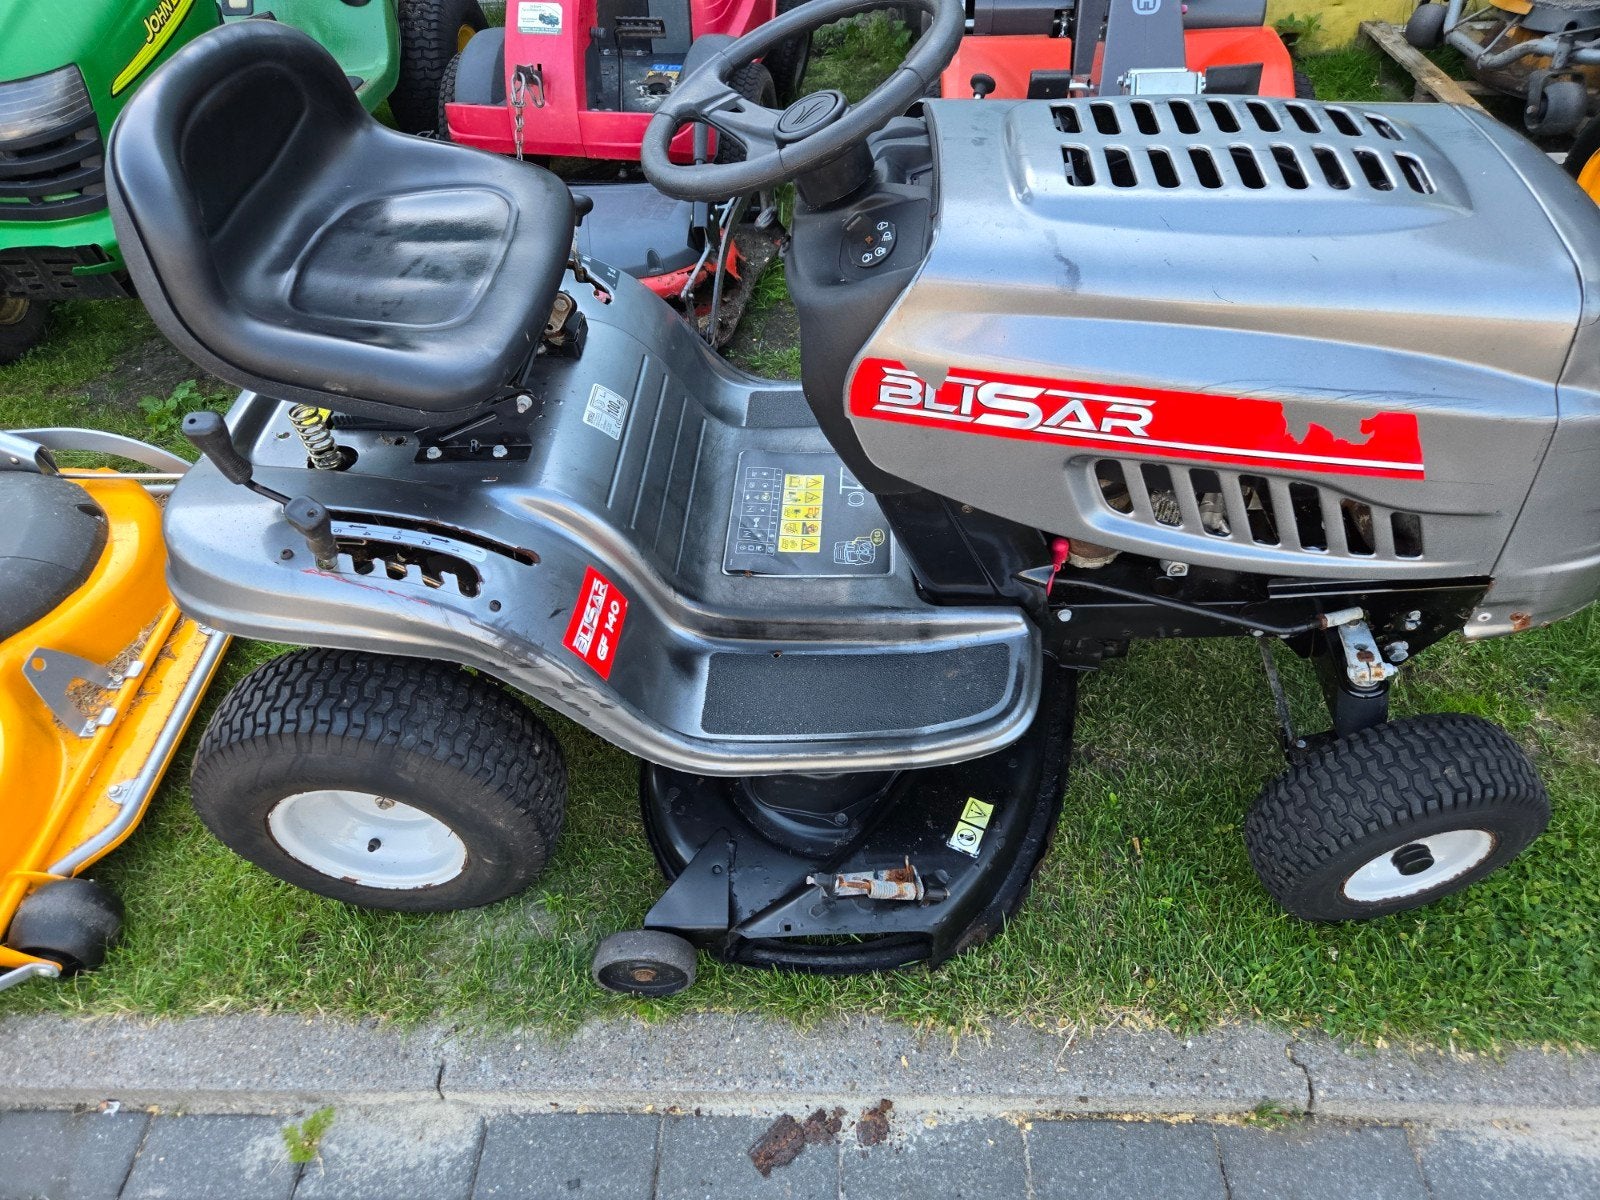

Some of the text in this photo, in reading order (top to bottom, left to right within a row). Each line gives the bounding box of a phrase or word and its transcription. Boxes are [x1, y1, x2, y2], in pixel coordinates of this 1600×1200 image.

[143, 0, 173, 43] JOHN
[607, 400, 621, 417] 100
[877, 370, 1154, 437] BLISAR
[572, 578, 608, 658] BLISAR
[604, 600, 620, 634] 140
